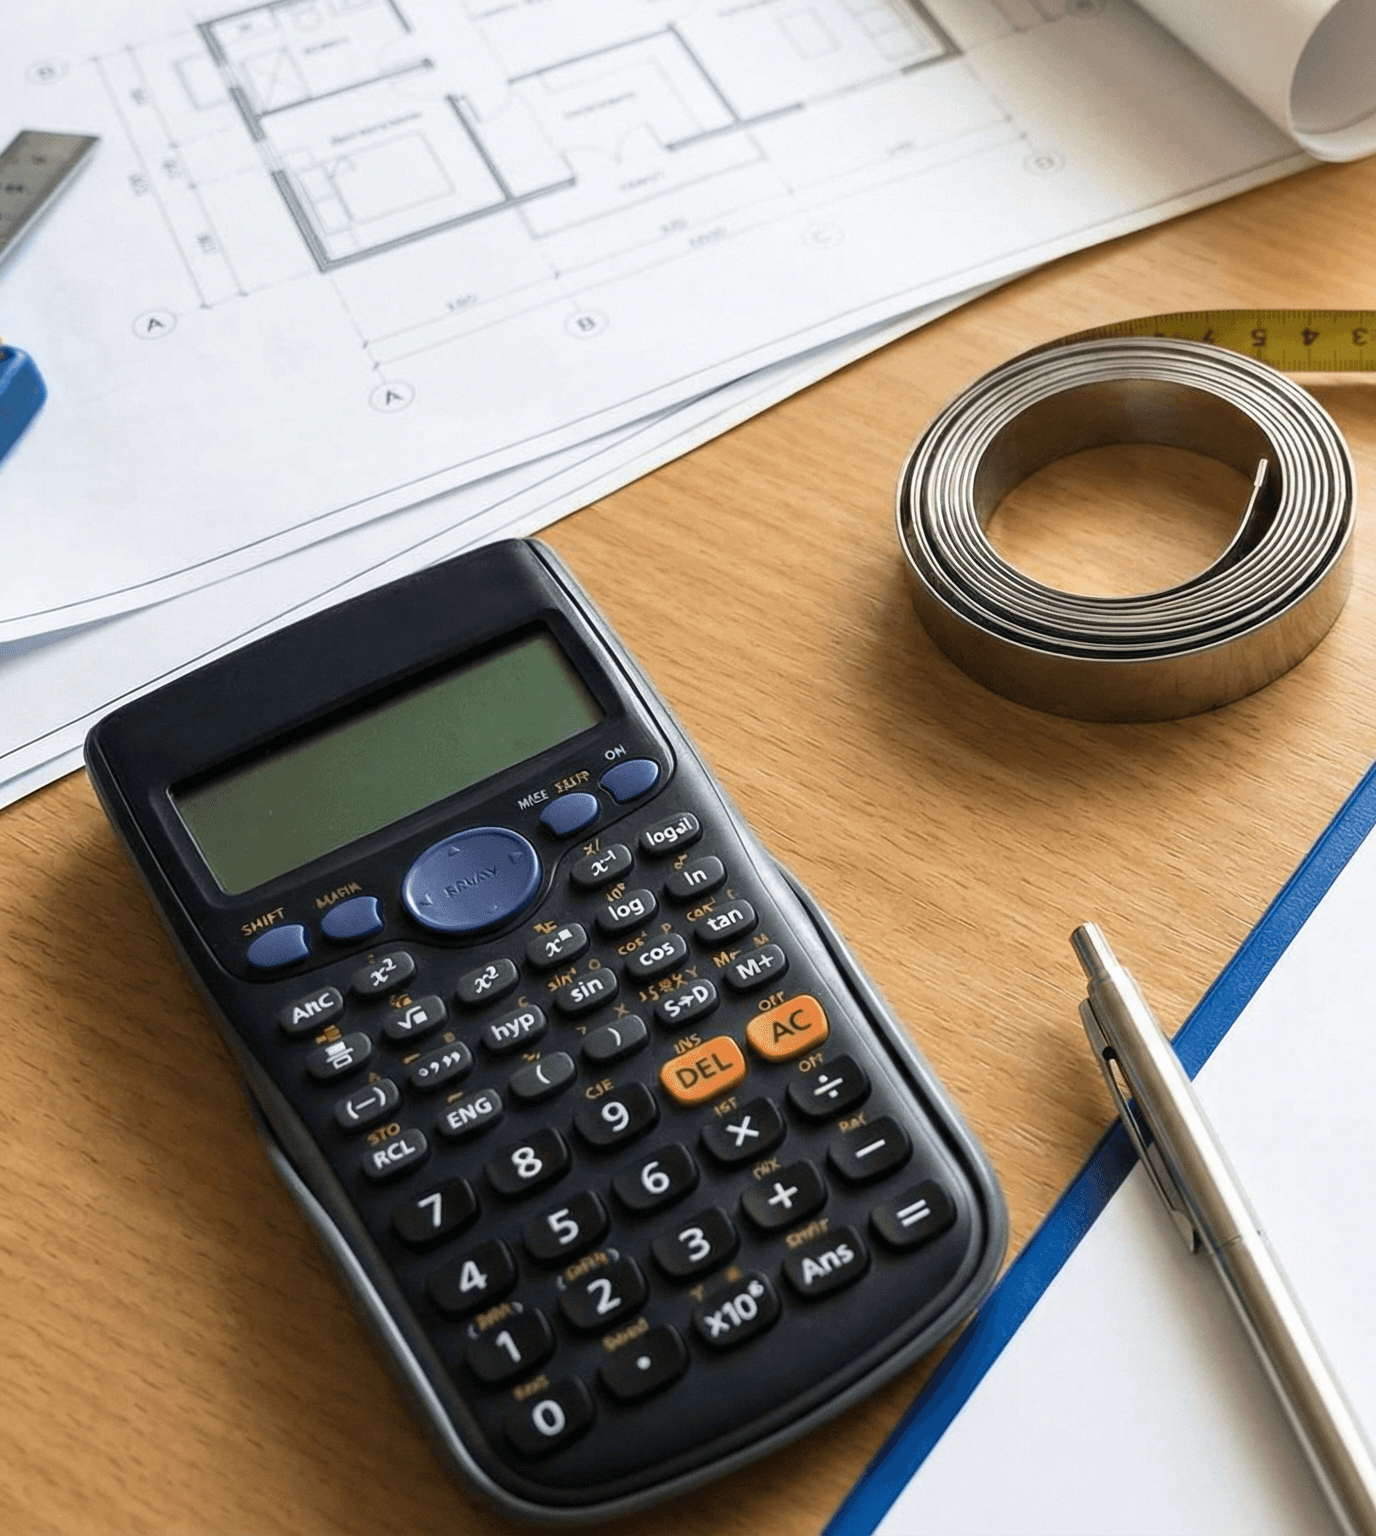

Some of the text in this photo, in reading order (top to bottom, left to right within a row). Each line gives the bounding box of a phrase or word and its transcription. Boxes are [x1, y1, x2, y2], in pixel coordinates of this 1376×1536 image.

[147, 317, 165, 333] A
[384, 389, 403, 405] A
[605, 744, 627, 762] ON
[684, 866, 708, 886] ln
[240, 906, 285, 937] SHIFT
[608, 898, 645, 921] log
[706, 908, 744, 932] tan
[639, 942, 675, 966] cos
[735, 953, 774, 980] M+
[570, 978, 604, 1003] sin
[490, 1012, 535, 1041] hyp
[772, 1008, 813, 1044] AC
[675, 1053, 734, 1090] DEL
[446, 1097, 493, 1130] ENG
[601, 1101, 630, 1133] 9
[367, 1122, 401, 1146] STO
[372, 1139, 416, 1170] RCL
[511, 1146, 543, 1179] 8
[640, 1160, 670, 1194] 6
[417, 1192, 443, 1228] 7
[547, 1207, 579, 1245] 5
[678, 1227, 711, 1262] 3
[458, 1259, 488, 1293] 4
[800, 1243, 855, 1286] Ans
[586, 1278, 622, 1316] 2
[495, 1330, 522, 1363] 1
[531, 1399, 566, 1436] 0
